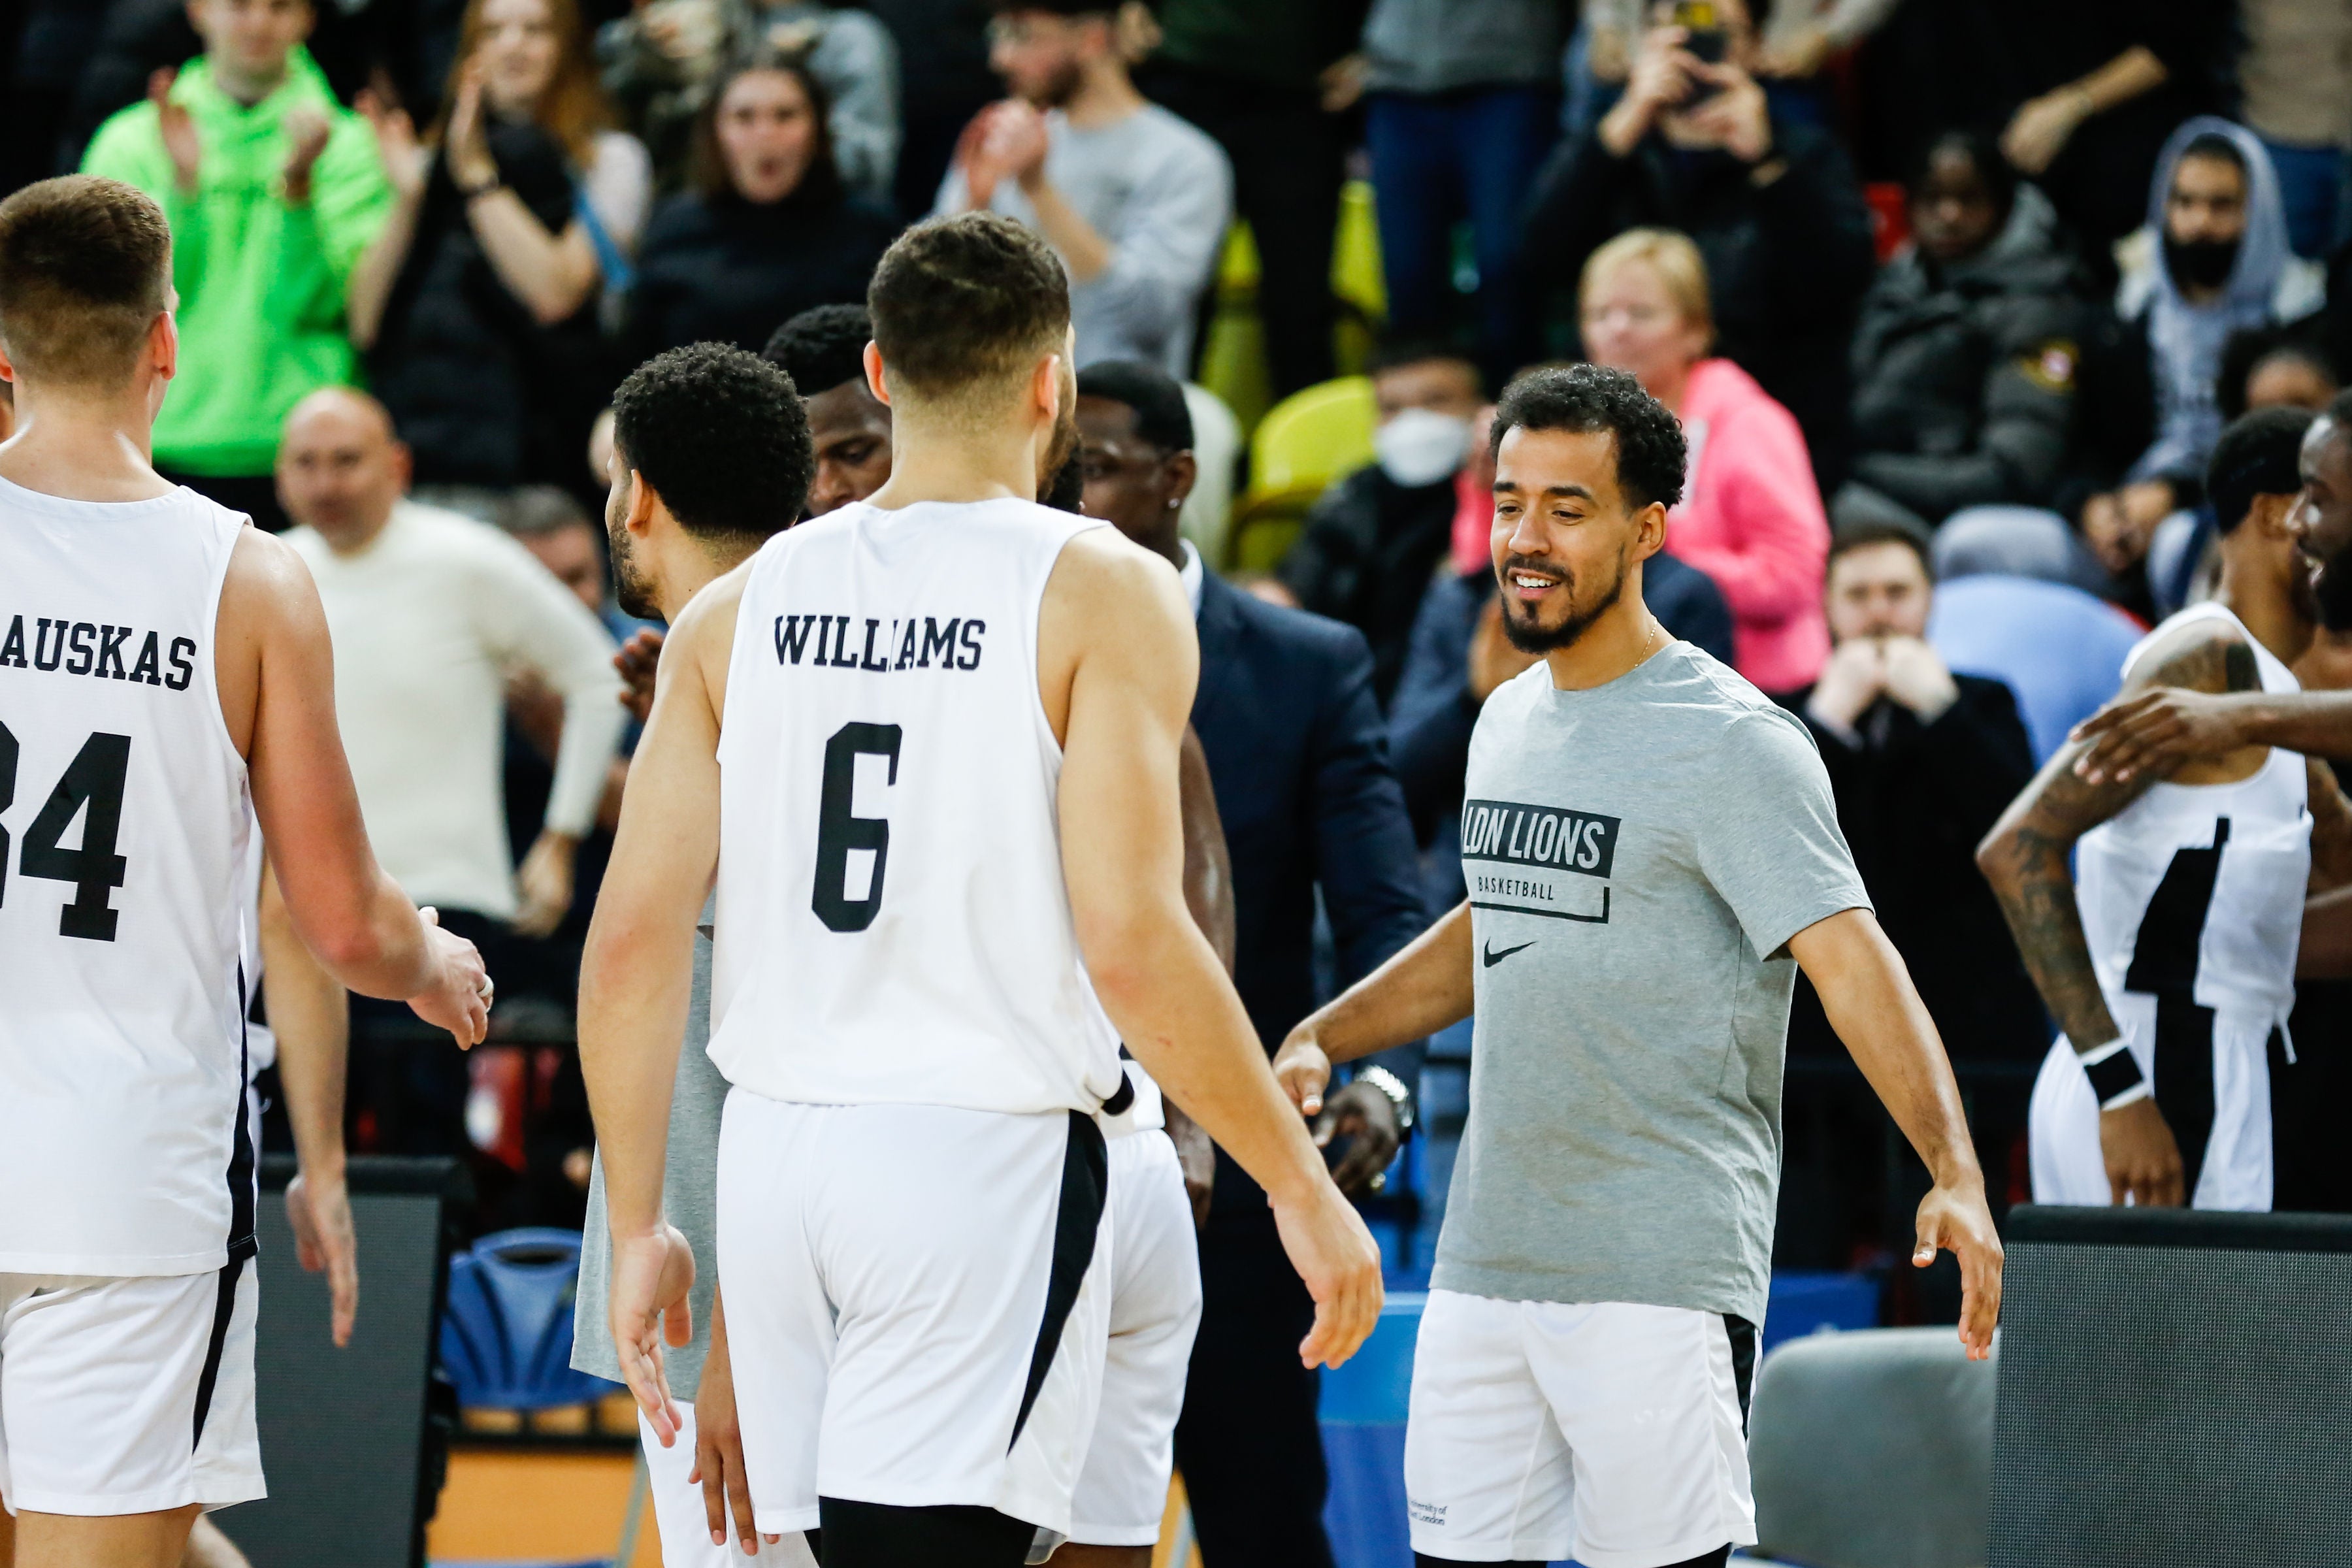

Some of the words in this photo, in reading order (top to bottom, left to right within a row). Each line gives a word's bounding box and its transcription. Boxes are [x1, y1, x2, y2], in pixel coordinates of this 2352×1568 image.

[0, 614, 196, 691] AUSKAS
[774, 615, 986, 672] WILLAMS
[0, 721, 131, 942] 4
[811, 721, 902, 932] 6
[1463, 806, 1509, 855] LDN
[1507, 810, 1605, 870] LIONS
[1477, 876, 1554, 901] BASKETBALL
